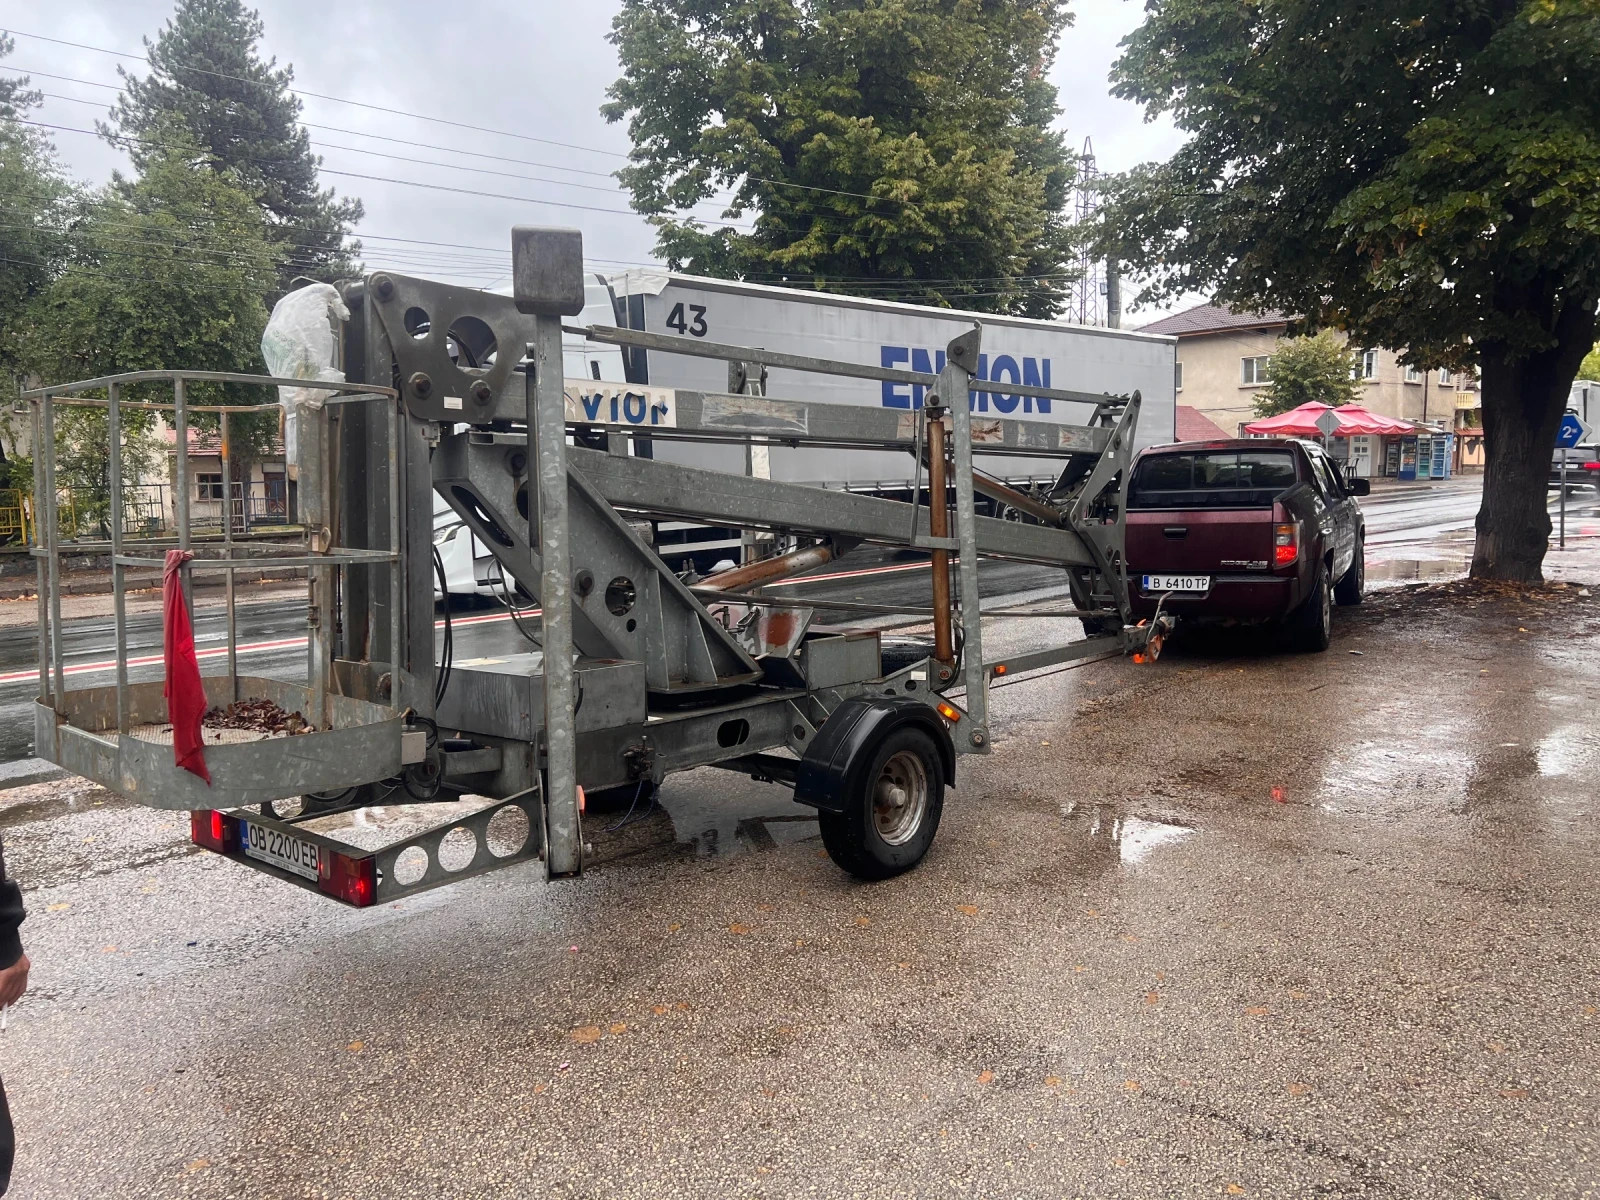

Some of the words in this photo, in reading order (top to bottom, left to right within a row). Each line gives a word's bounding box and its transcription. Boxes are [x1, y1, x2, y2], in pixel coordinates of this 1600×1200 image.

[666, 302, 707, 337] 43
[1153, 578, 1161, 589] B
[1166, 578, 1192, 589] 6410
[1195, 579, 1208, 589] TP
[249, 824, 267, 851] OB
[268, 830, 300, 863] 2200
[301, 841, 318, 871] EB
